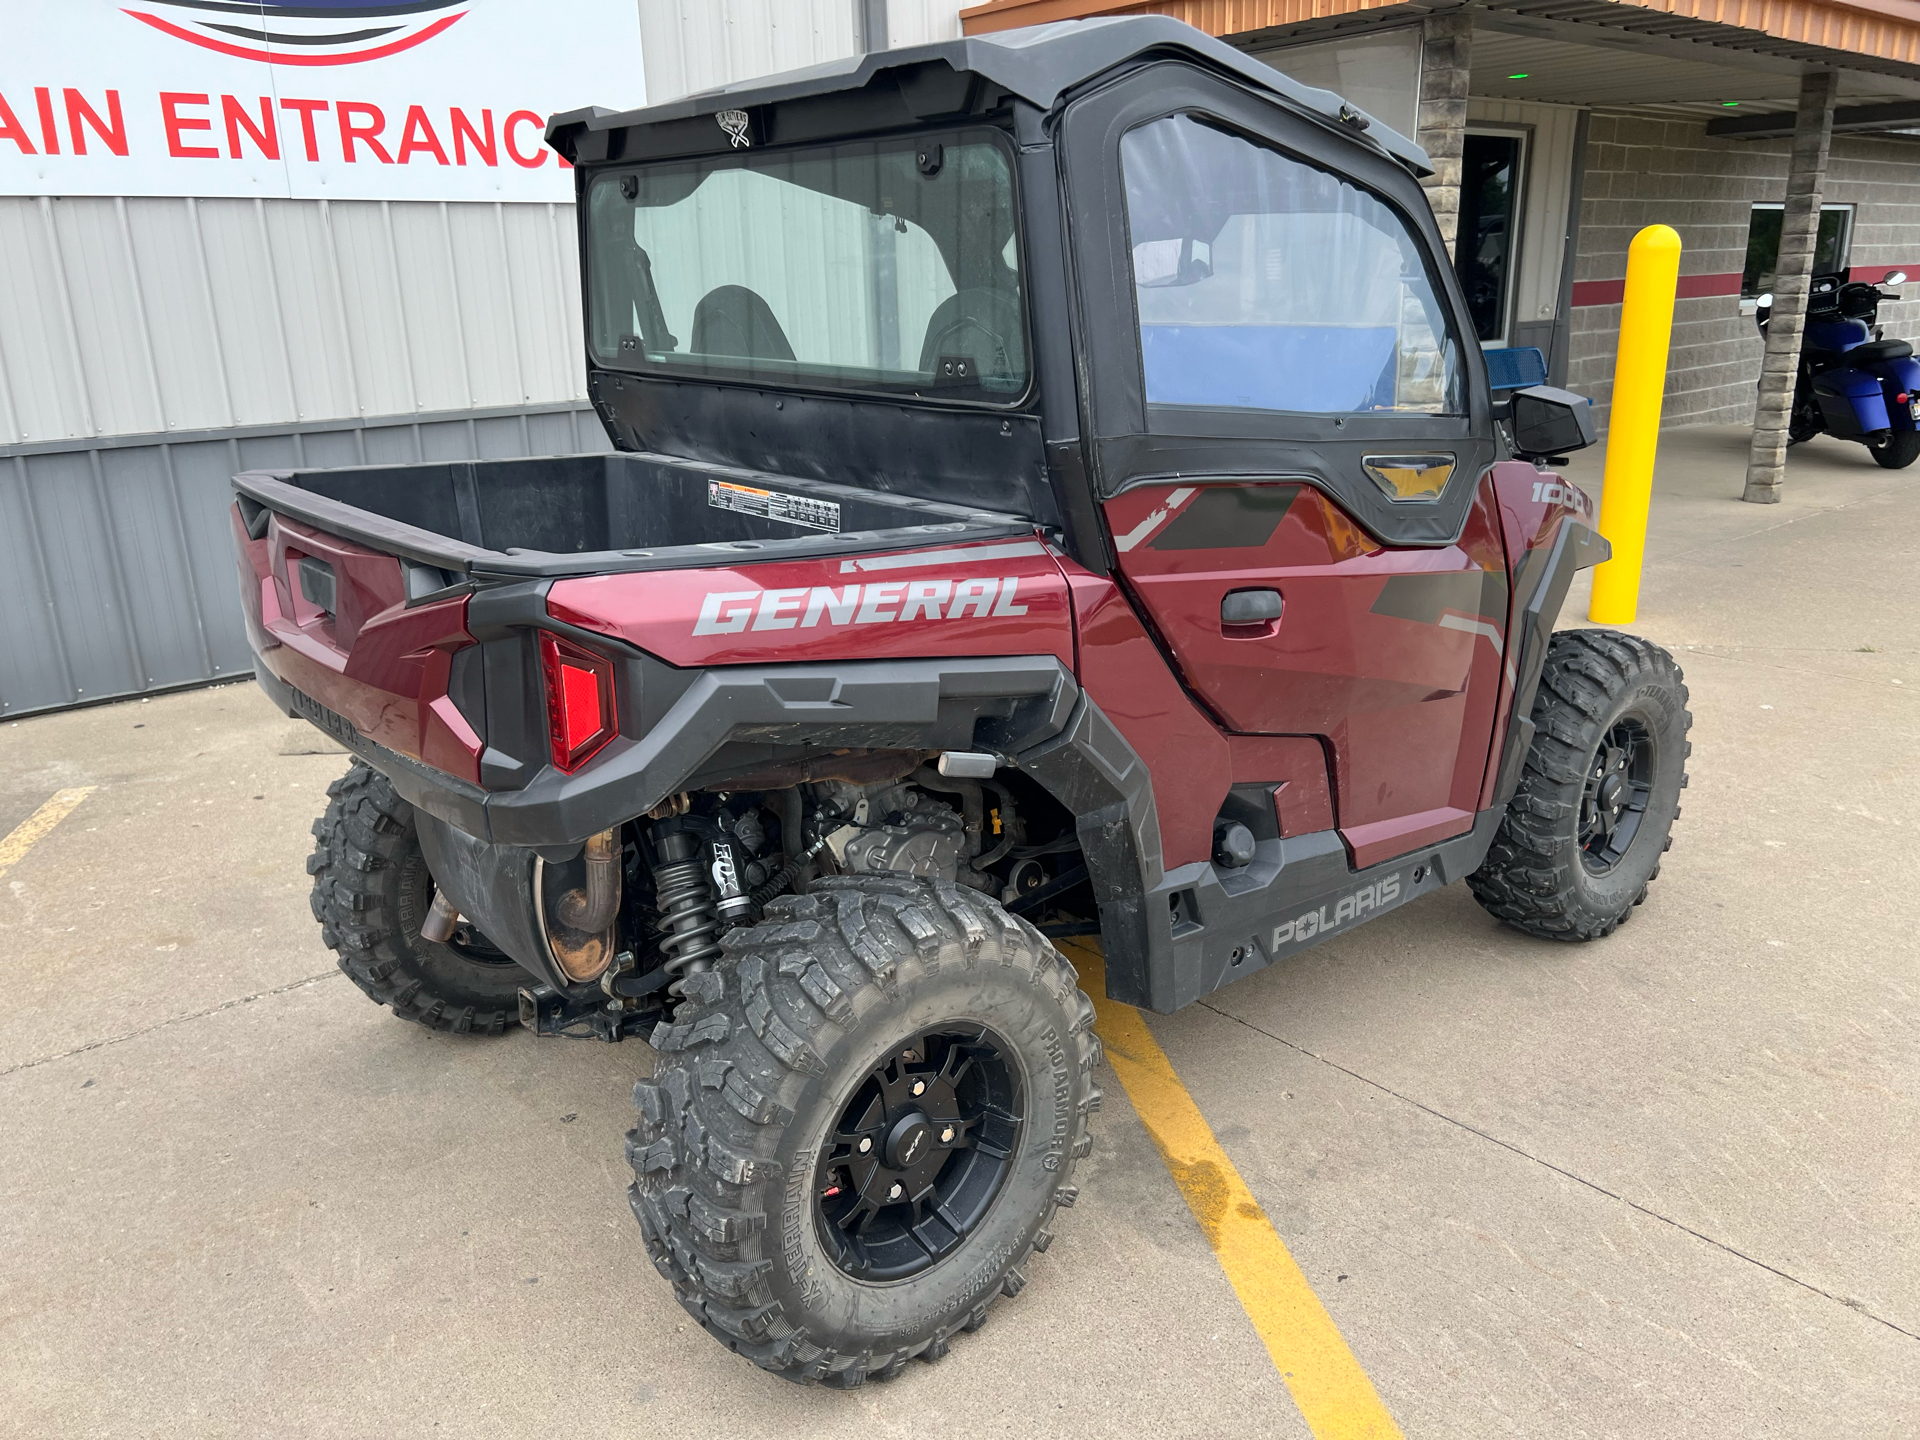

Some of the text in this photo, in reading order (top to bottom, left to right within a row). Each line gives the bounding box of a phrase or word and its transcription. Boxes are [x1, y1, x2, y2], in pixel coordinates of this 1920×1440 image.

[159, 92, 575, 169] ENTRANC
[1531, 482, 1584, 514] 1000
[691, 576, 1029, 637] GENERAL
[1272, 872, 1400, 954] POLARIS
[1040, 1026, 1070, 1150] PRO ARMOR
[781, 1150, 823, 1312] X-TERRAIN
